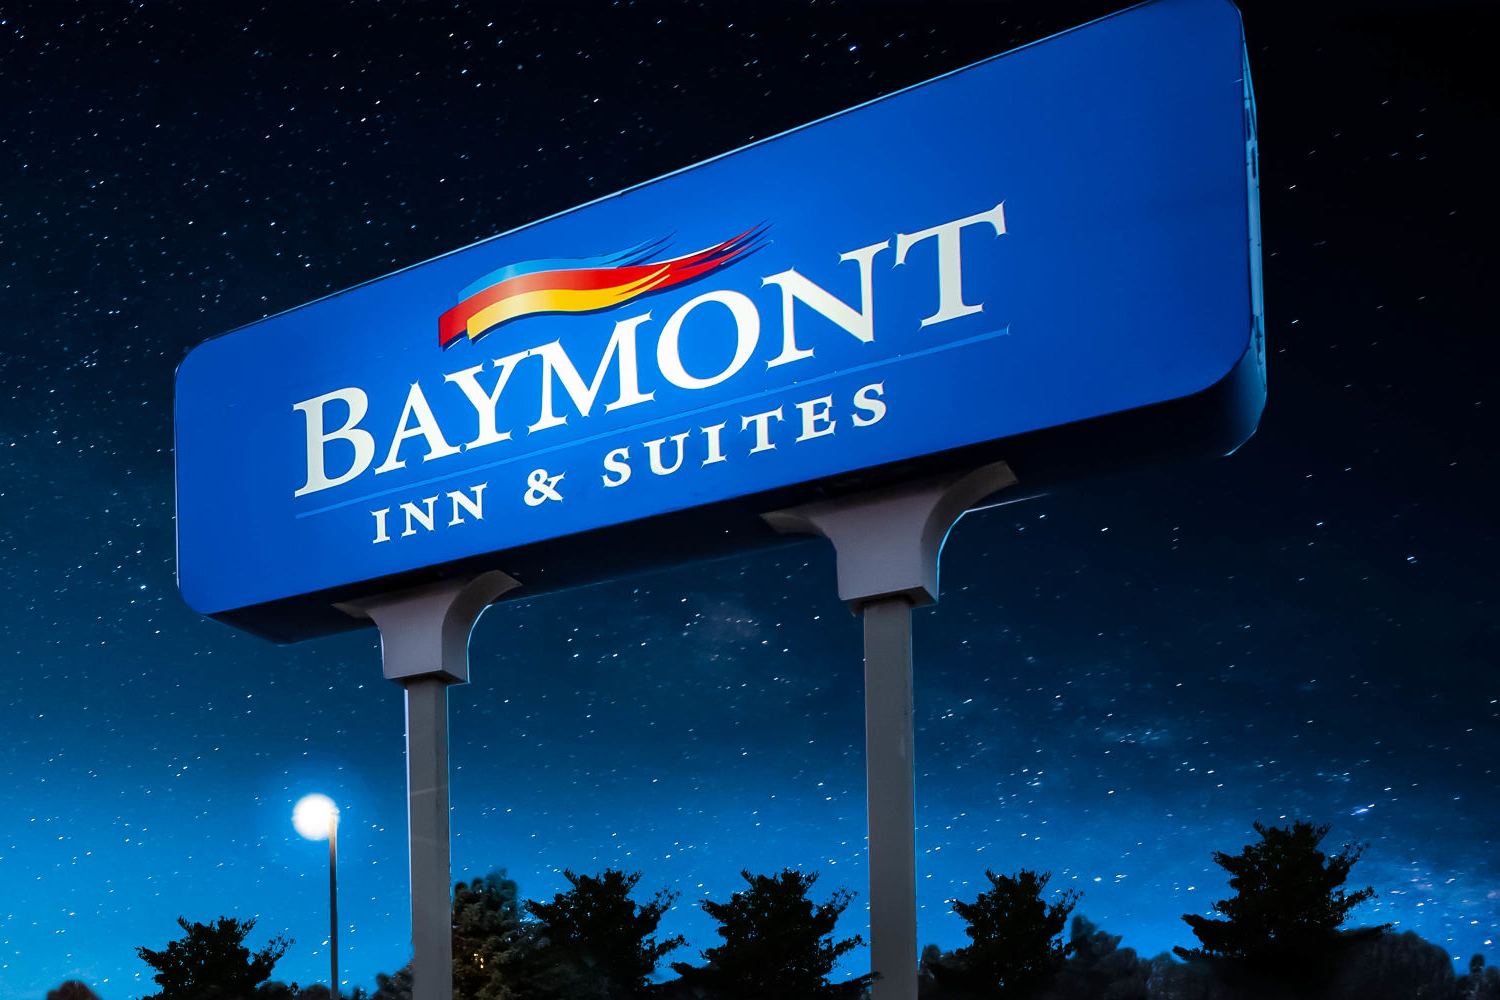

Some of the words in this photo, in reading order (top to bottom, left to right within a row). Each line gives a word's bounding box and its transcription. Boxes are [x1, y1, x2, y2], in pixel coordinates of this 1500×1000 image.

[294, 203, 1006, 497] BAYMONT
[372, 482, 488, 544] INN
[523, 468, 566, 507] &
[602, 382, 888, 488] SUITES
